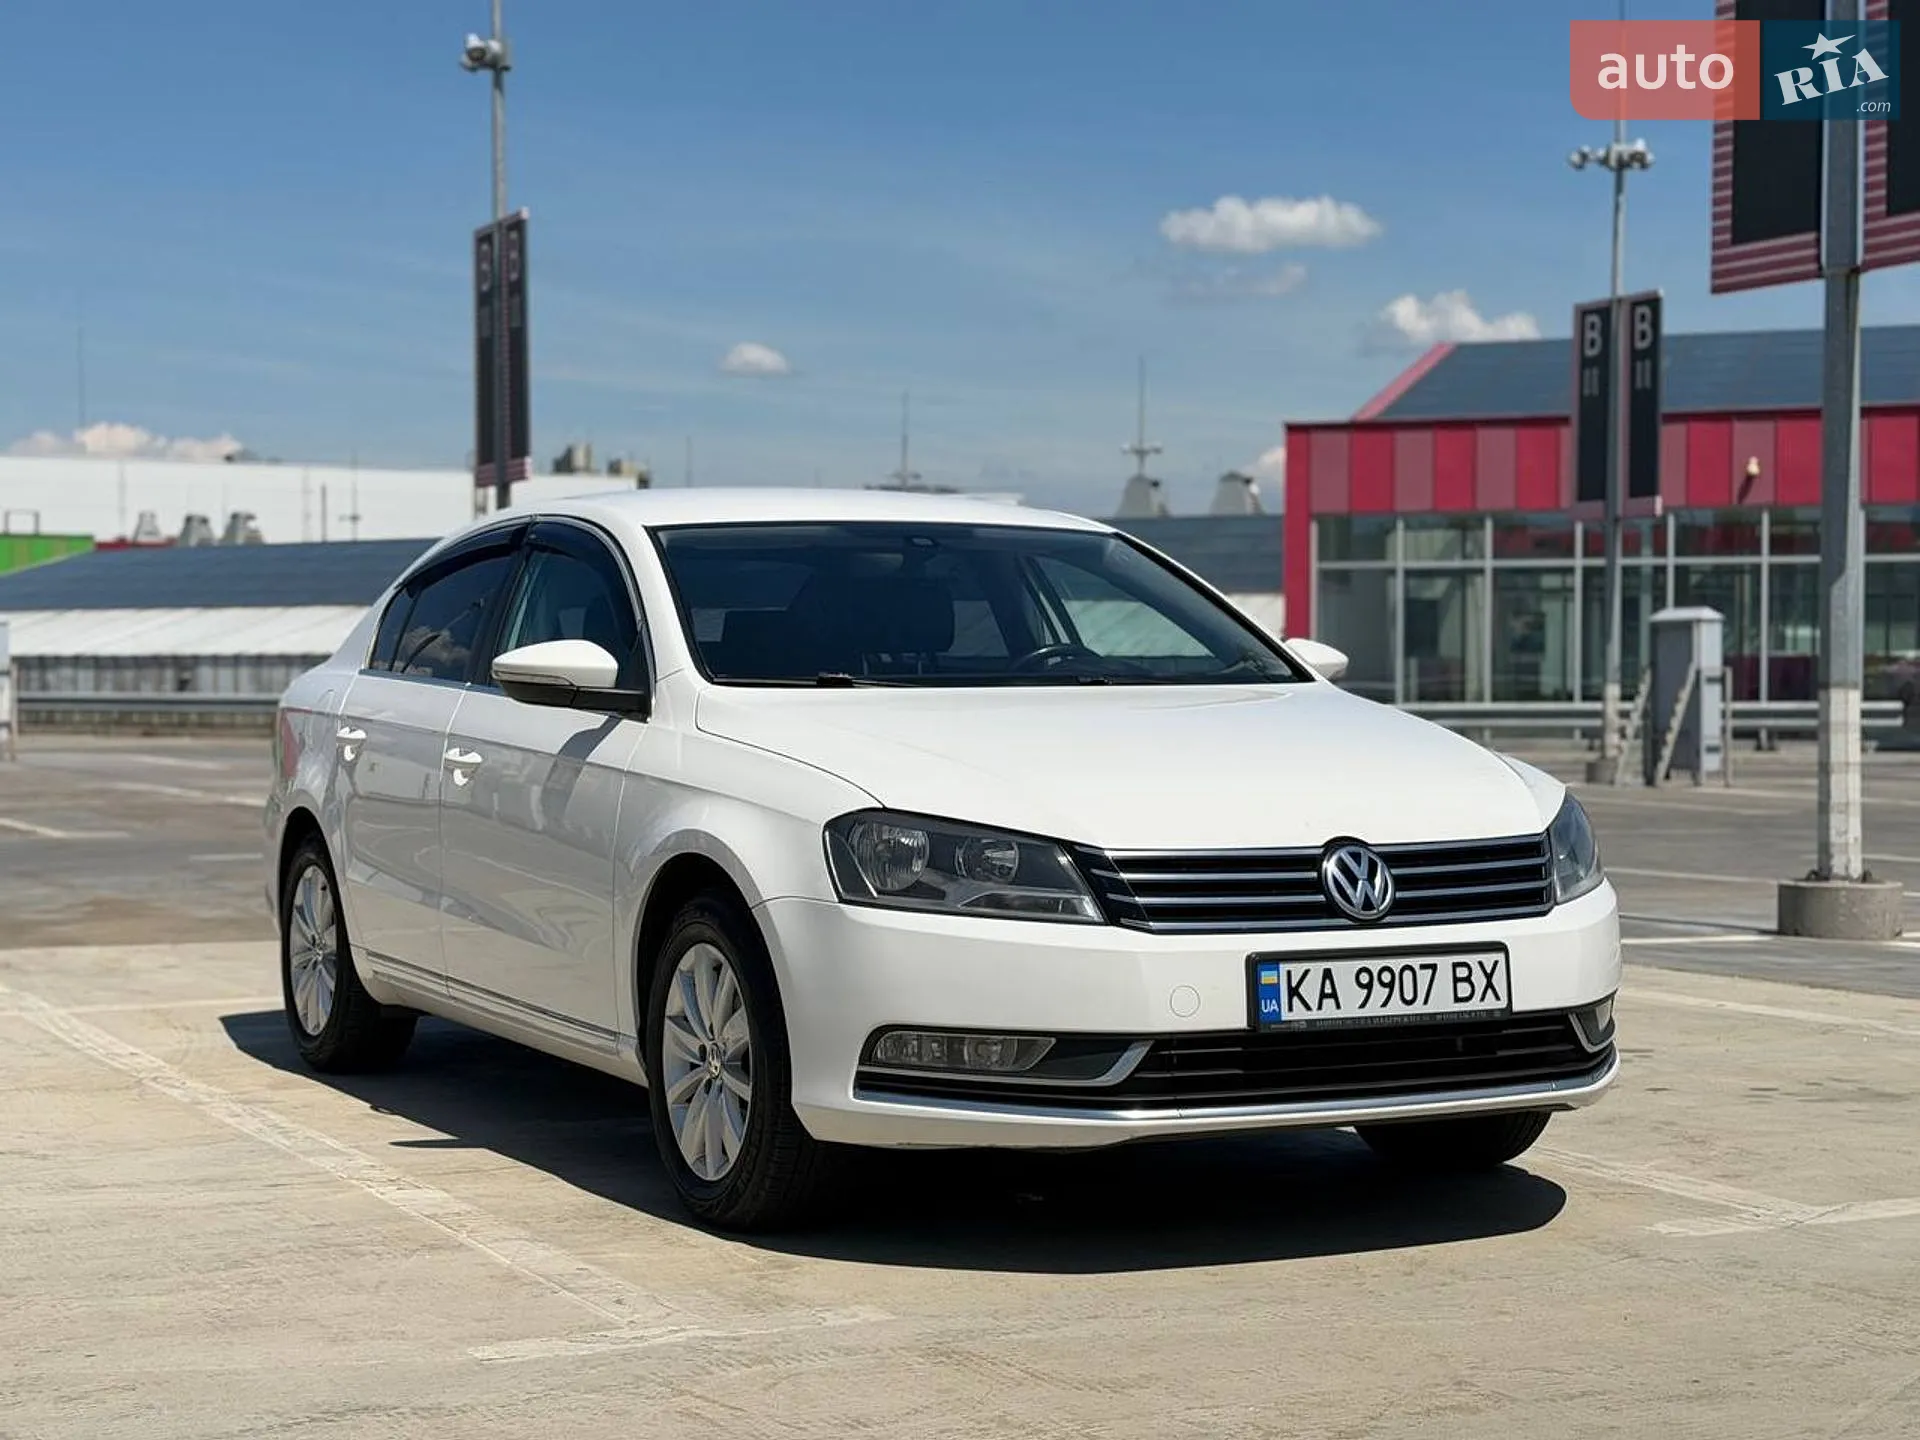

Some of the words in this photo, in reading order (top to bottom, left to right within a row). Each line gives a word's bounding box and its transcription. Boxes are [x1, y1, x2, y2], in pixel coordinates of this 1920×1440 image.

[1583, 313, 1602, 357] B
[1634, 304, 1653, 350] B
[1261, 1000, 1280, 1014] UA
[1286, 967, 1342, 1013] KA
[1354, 963, 1438, 1009] 9907
[1451, 959, 1501, 1004] BX
